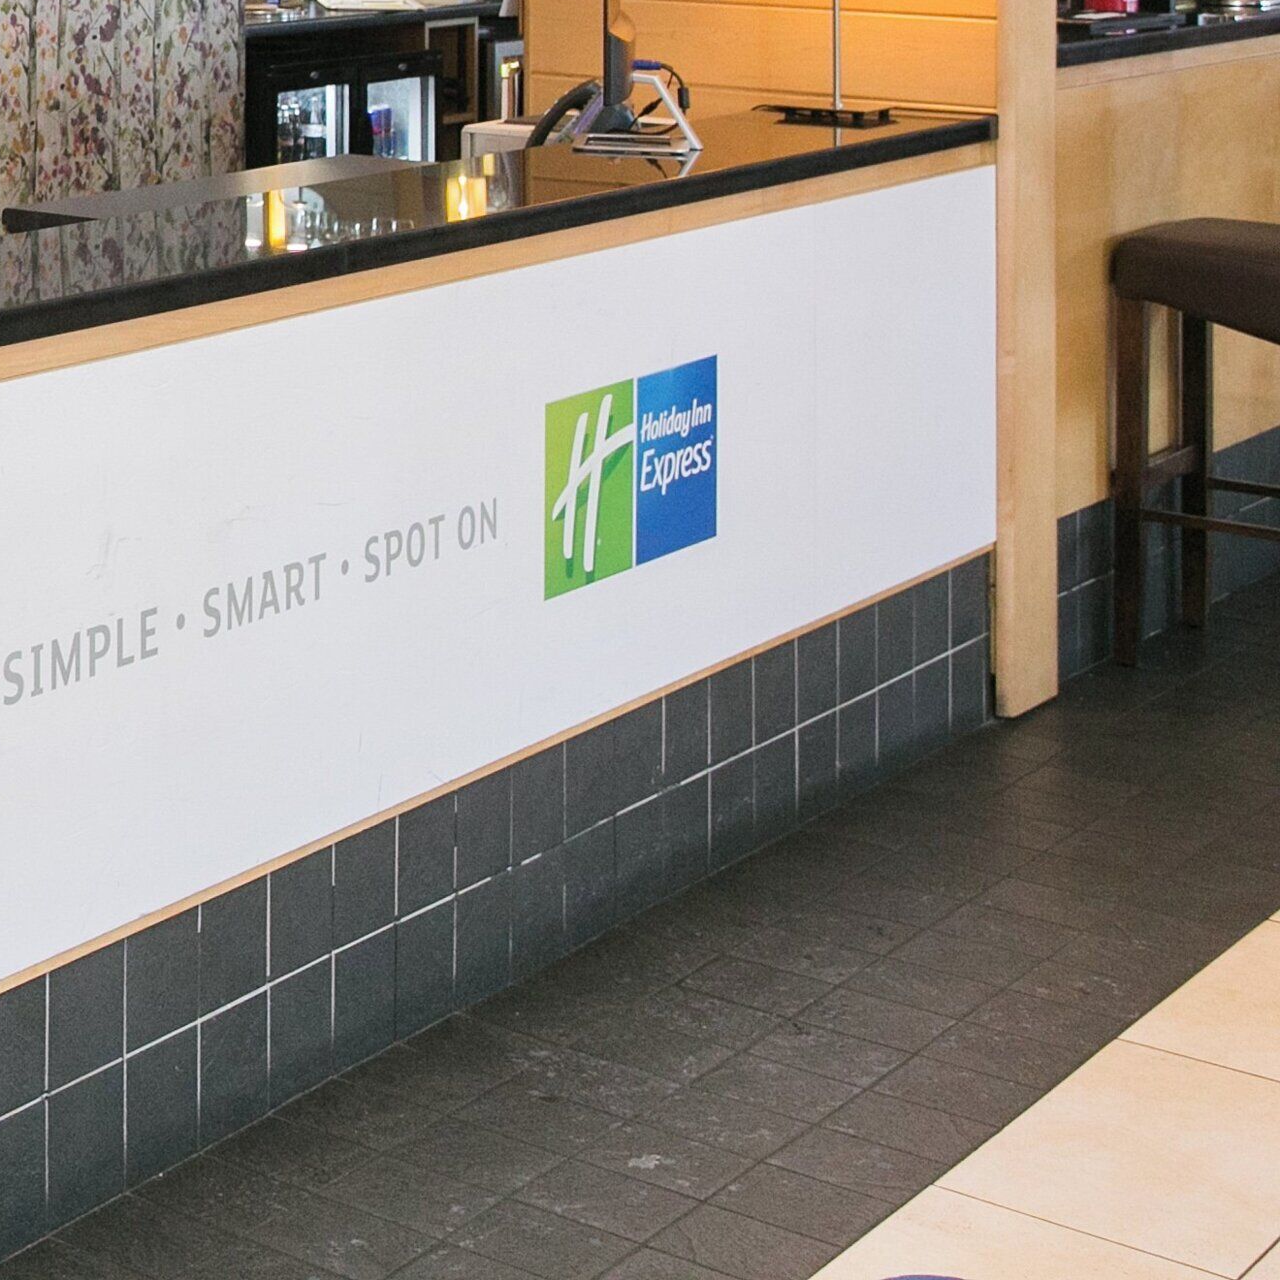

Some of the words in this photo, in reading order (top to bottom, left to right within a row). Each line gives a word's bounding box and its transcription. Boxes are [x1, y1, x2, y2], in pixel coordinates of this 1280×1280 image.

[641, 404, 690, 443] Holiday
[691, 398, 712, 426] Inn
[641, 439, 712, 495] Express
[2, 607, 159, 706] SIMPLE
[203, 552, 327, 639] SMART
[364, 515, 446, 584] SPOT
[457, 497, 499, 551] ON
